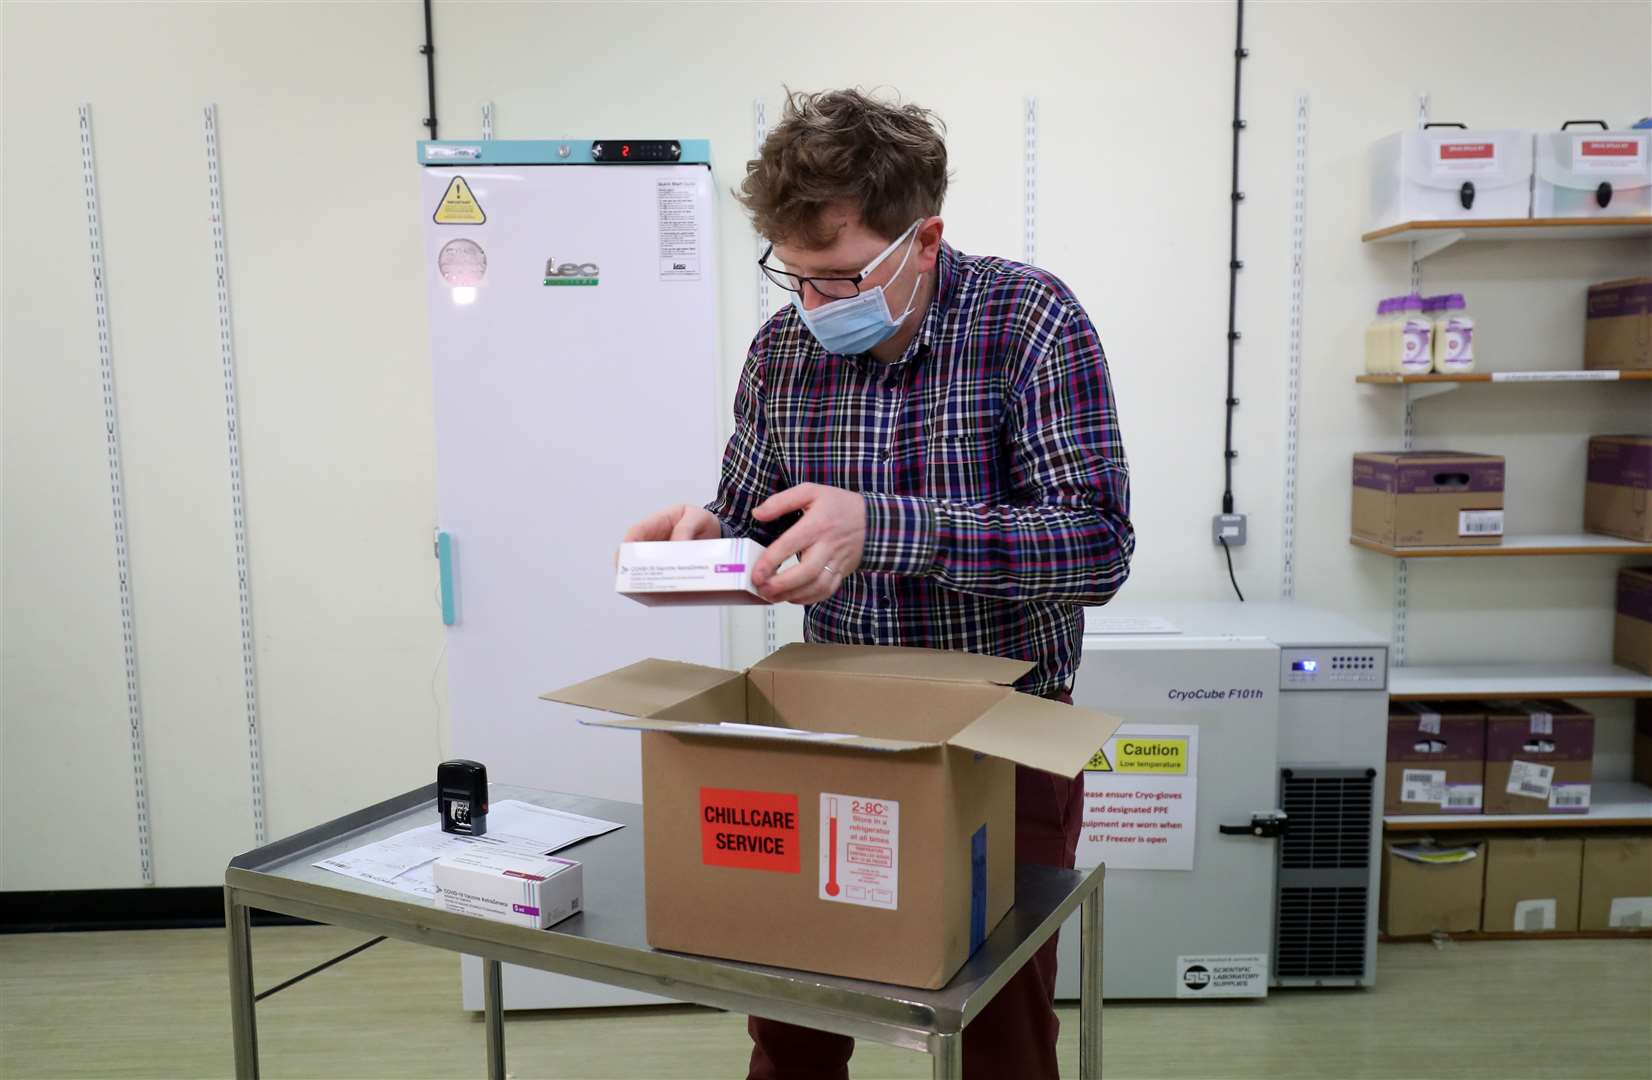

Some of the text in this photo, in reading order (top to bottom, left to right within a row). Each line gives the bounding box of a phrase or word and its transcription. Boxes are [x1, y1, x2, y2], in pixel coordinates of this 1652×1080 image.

[622, 145, 629, 157] 2
[545, 256, 599, 277] Lec
[1168, 689, 1263, 700] CryoCube F101h
[1123, 743, 1179, 756] Caution
[1137, 761, 1181, 769] temperature
[1135, 791, 1182, 800] Cryo-gloves
[1107, 805, 1152, 814] designated
[704, 806, 795, 830] CHILLCARE
[853, 815, 872, 823] Store
[1081, 820, 1119, 829] quipment
[1159, 821, 1182, 829] when
[849, 824, 890, 835] refrigerator
[715, 832, 784, 855] SERVICE
[870, 835, 890, 844] times
[1138, 835, 1145, 843] is
[463, 892, 481, 901] Vaccine
